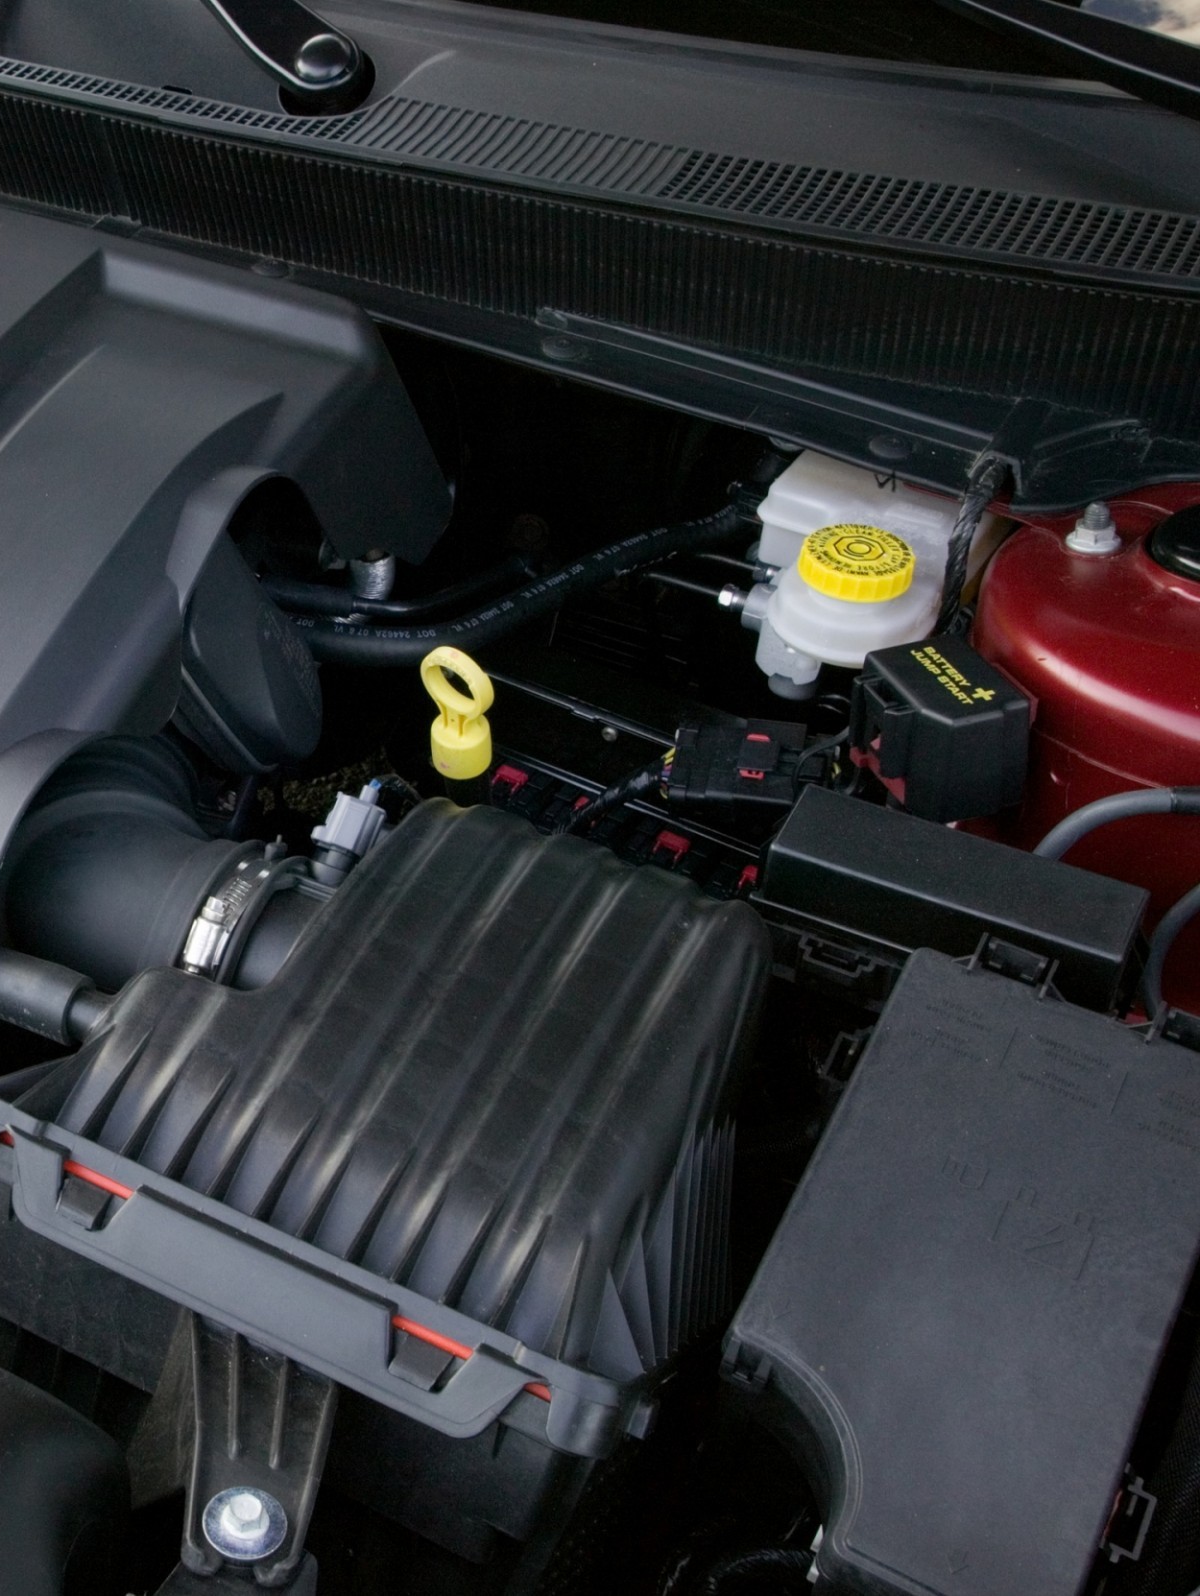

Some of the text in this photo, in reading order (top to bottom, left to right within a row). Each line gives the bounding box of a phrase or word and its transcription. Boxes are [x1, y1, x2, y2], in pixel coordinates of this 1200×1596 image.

[416, 628, 437, 639] DOT
[910, 649, 974, 705] JUMP START
[923, 646, 972, 687] BATTERY
